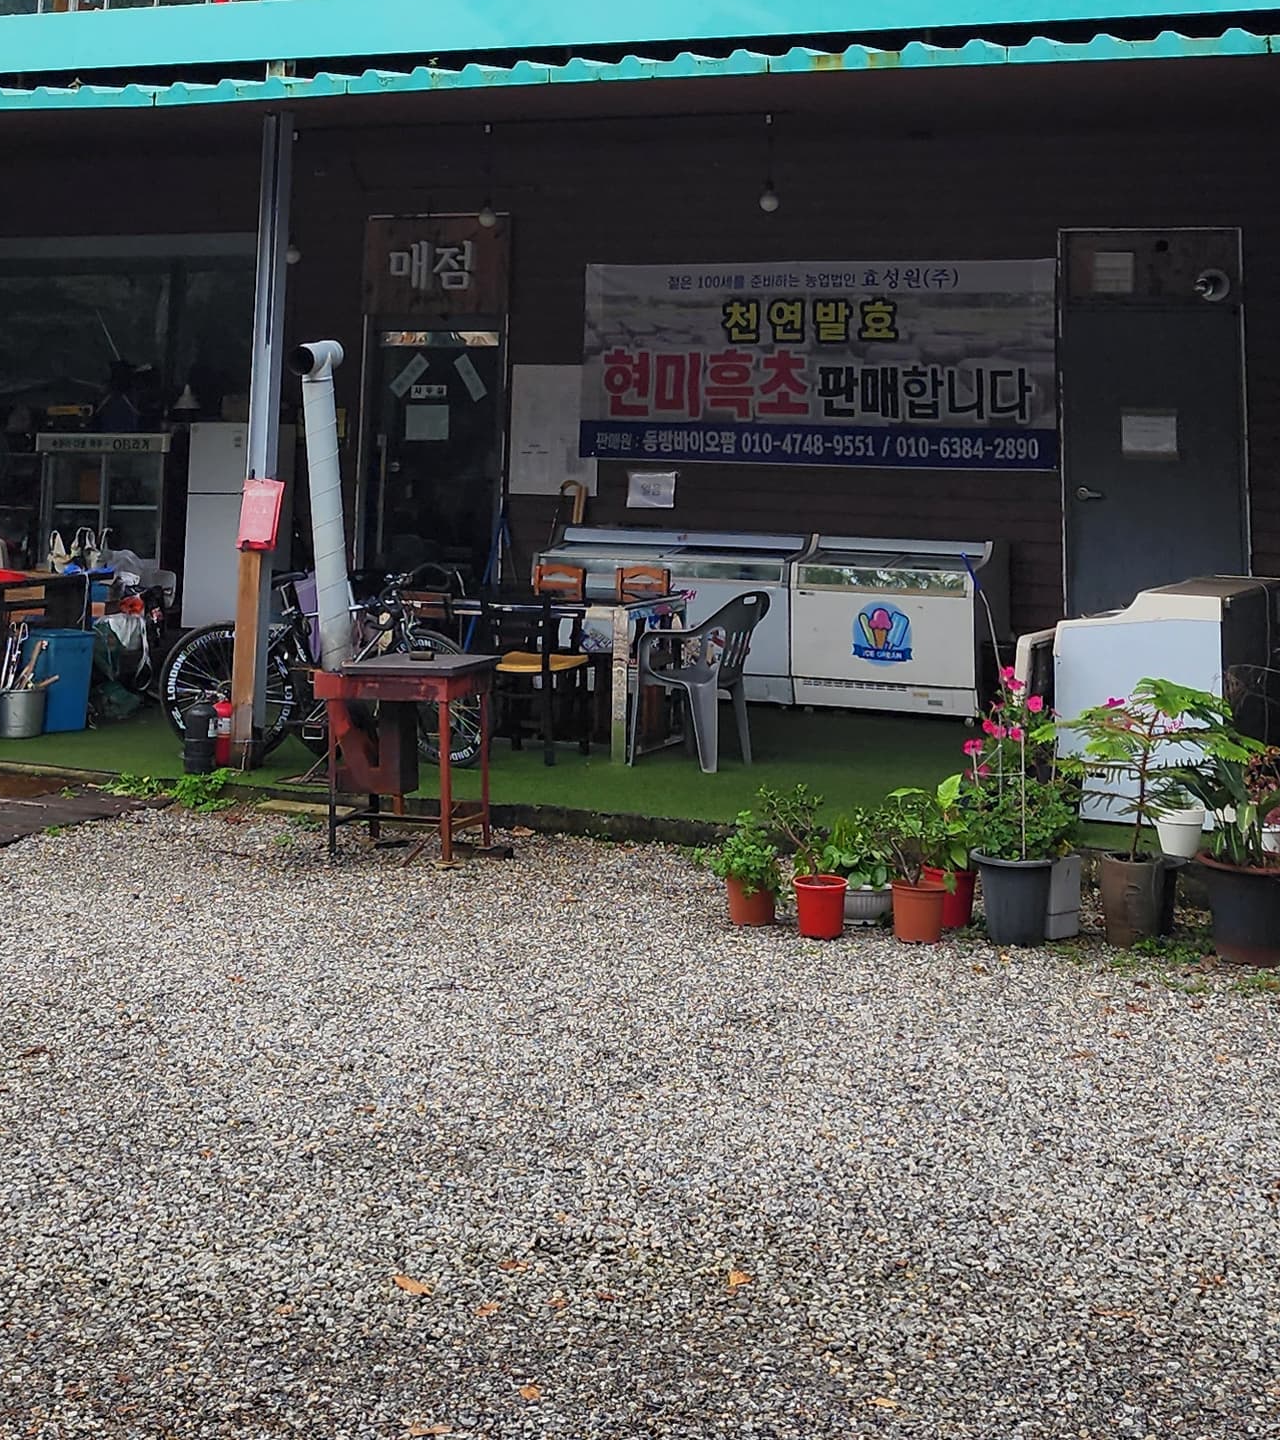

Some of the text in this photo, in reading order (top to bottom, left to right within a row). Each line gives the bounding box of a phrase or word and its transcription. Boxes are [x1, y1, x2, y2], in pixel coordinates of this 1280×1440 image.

[389, 240, 472, 290] 매점
[667, 268, 959, 290] 젊은 100세를 준비하는 농업법인 효성원(주)
[722, 298, 900, 344] 천연발효
[603, 347, 1032, 420] 현미흑초 판매합니다
[642, 429, 737, 455] 동방바이오팜
[741, 432, 875, 458] 010-4748-9551
[896, 435, 1040, 461] 010-6384-2890
[167, 650, 187, 701] LONDON
